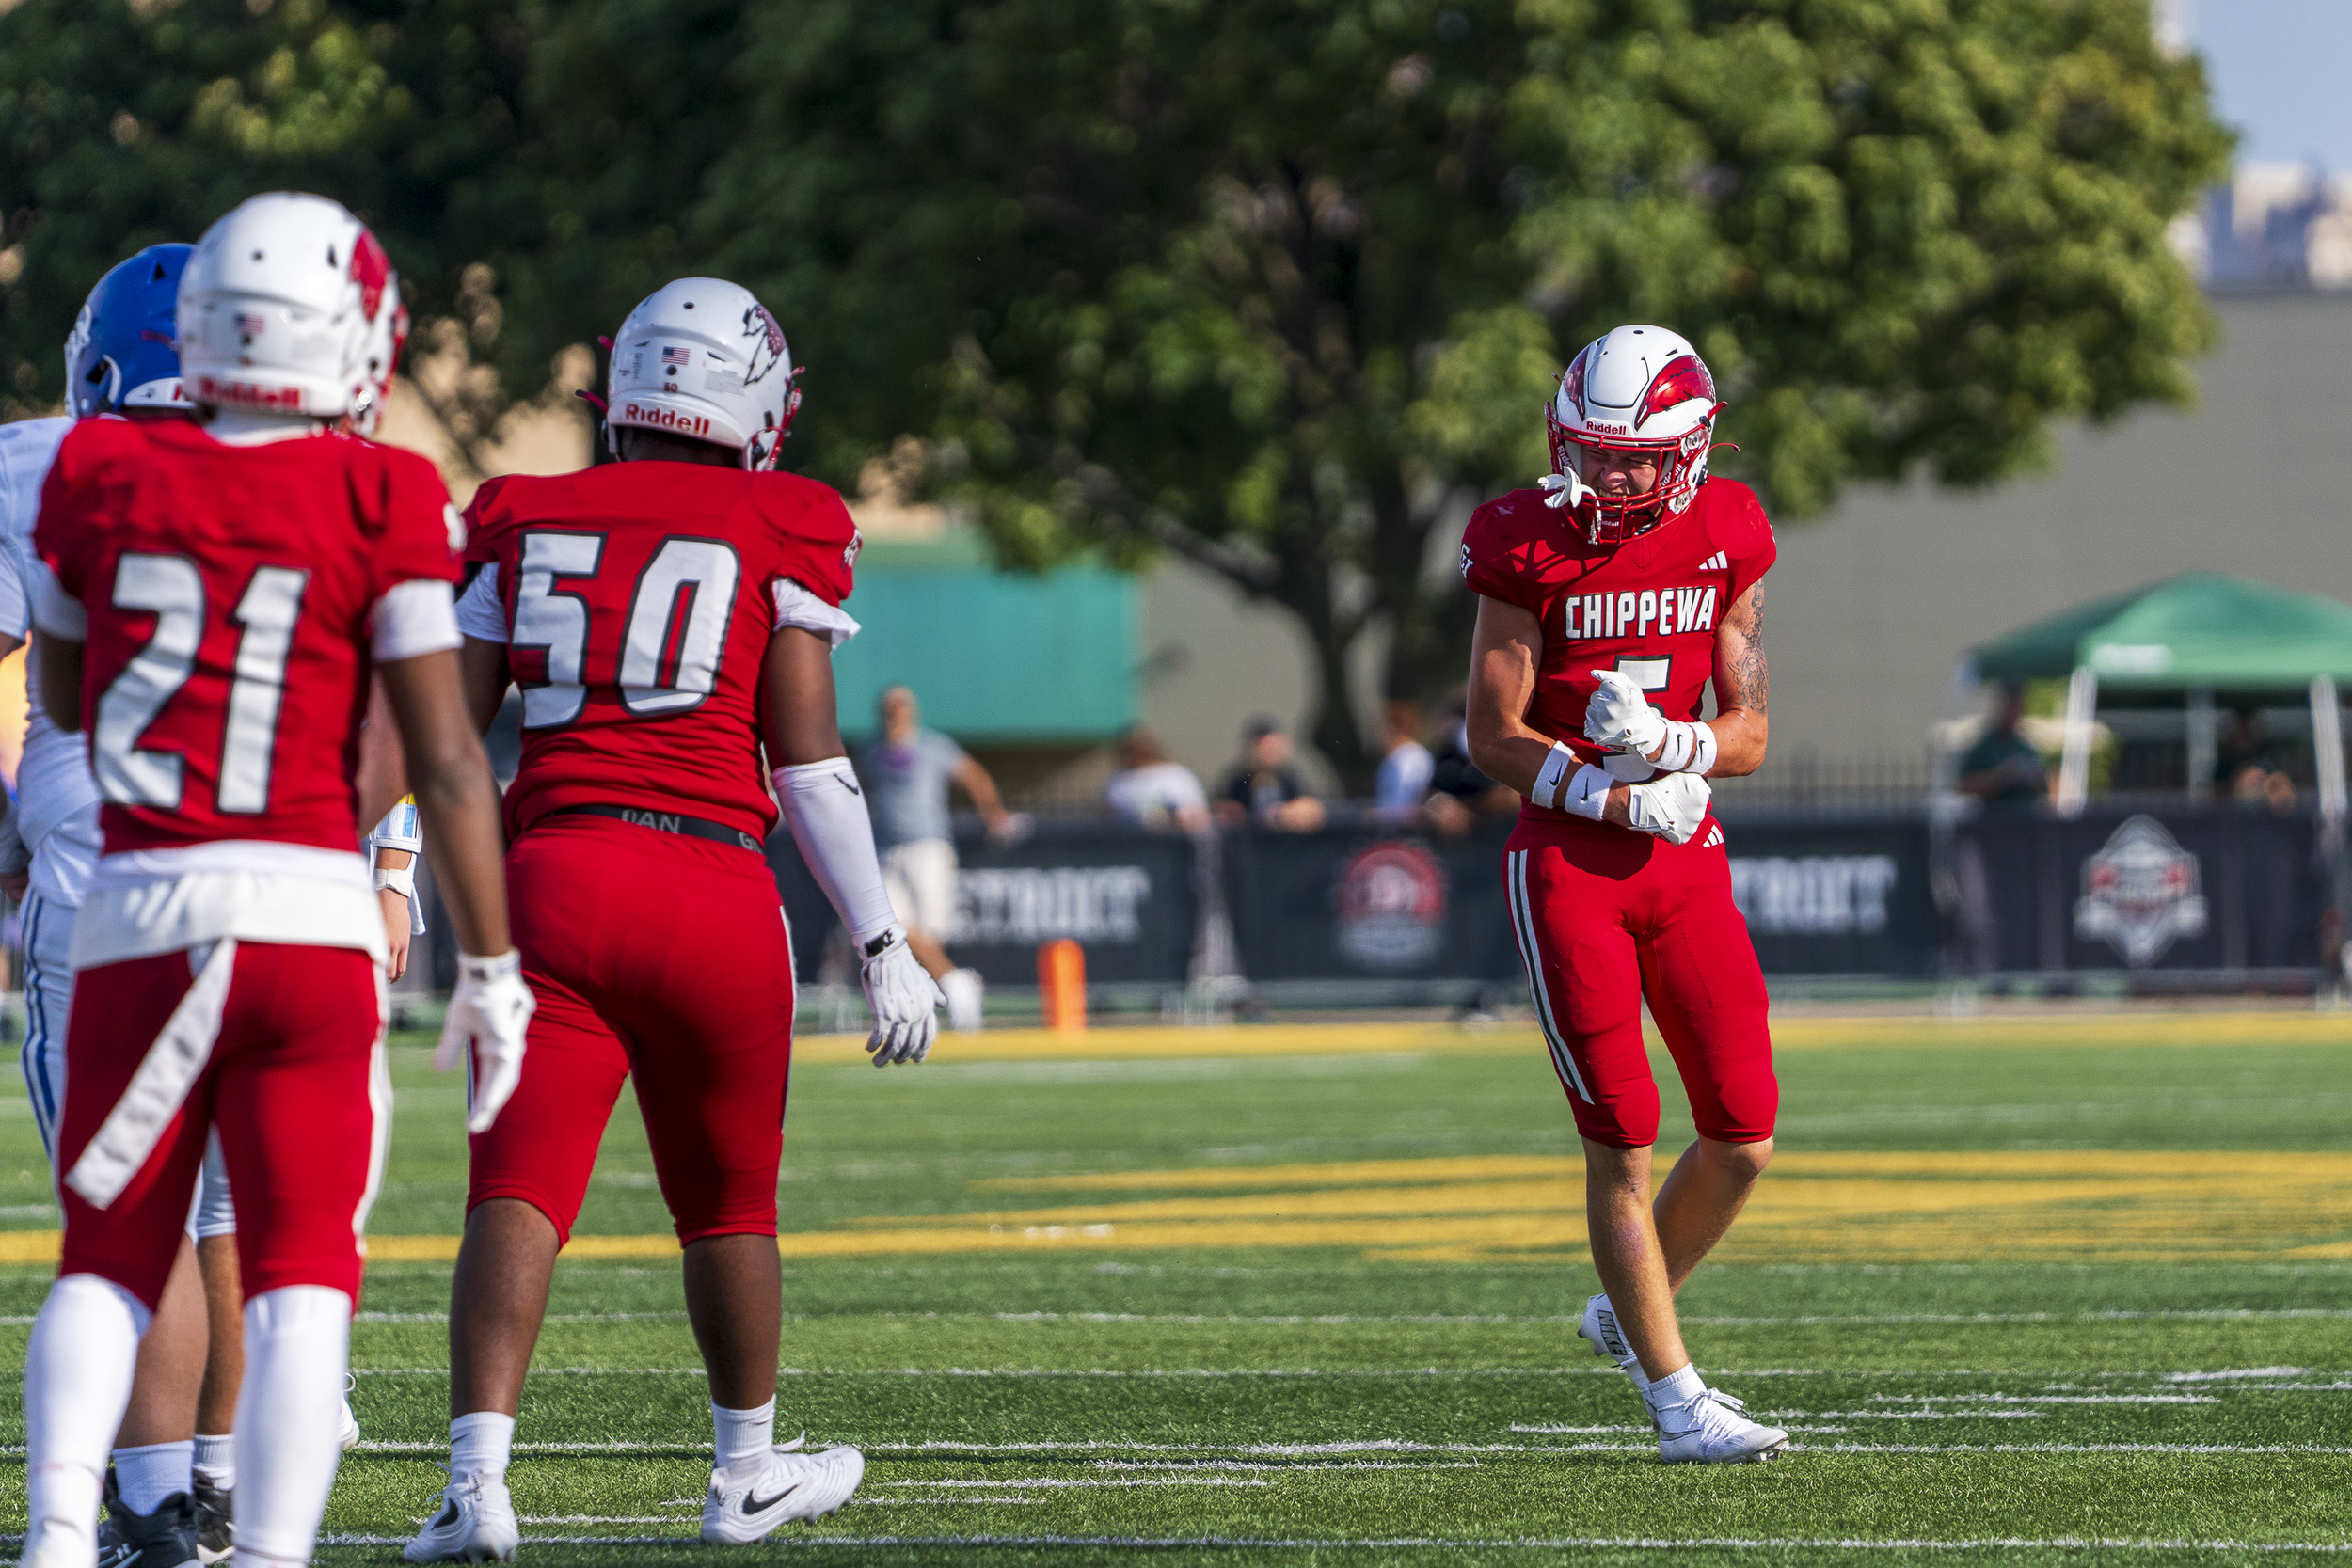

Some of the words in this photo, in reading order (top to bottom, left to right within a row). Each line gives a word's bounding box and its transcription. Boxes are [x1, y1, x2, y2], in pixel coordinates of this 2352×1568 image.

[663, 382, 678, 393] 50
[626, 403, 710, 436] Riddell
[1586, 420, 1627, 436] Riddell
[511, 528, 742, 730] 50
[1565, 585, 1717, 640] CHIPPEWA
[94, 550, 311, 815] 21
[1597, 1309, 1629, 1356] NIKE
